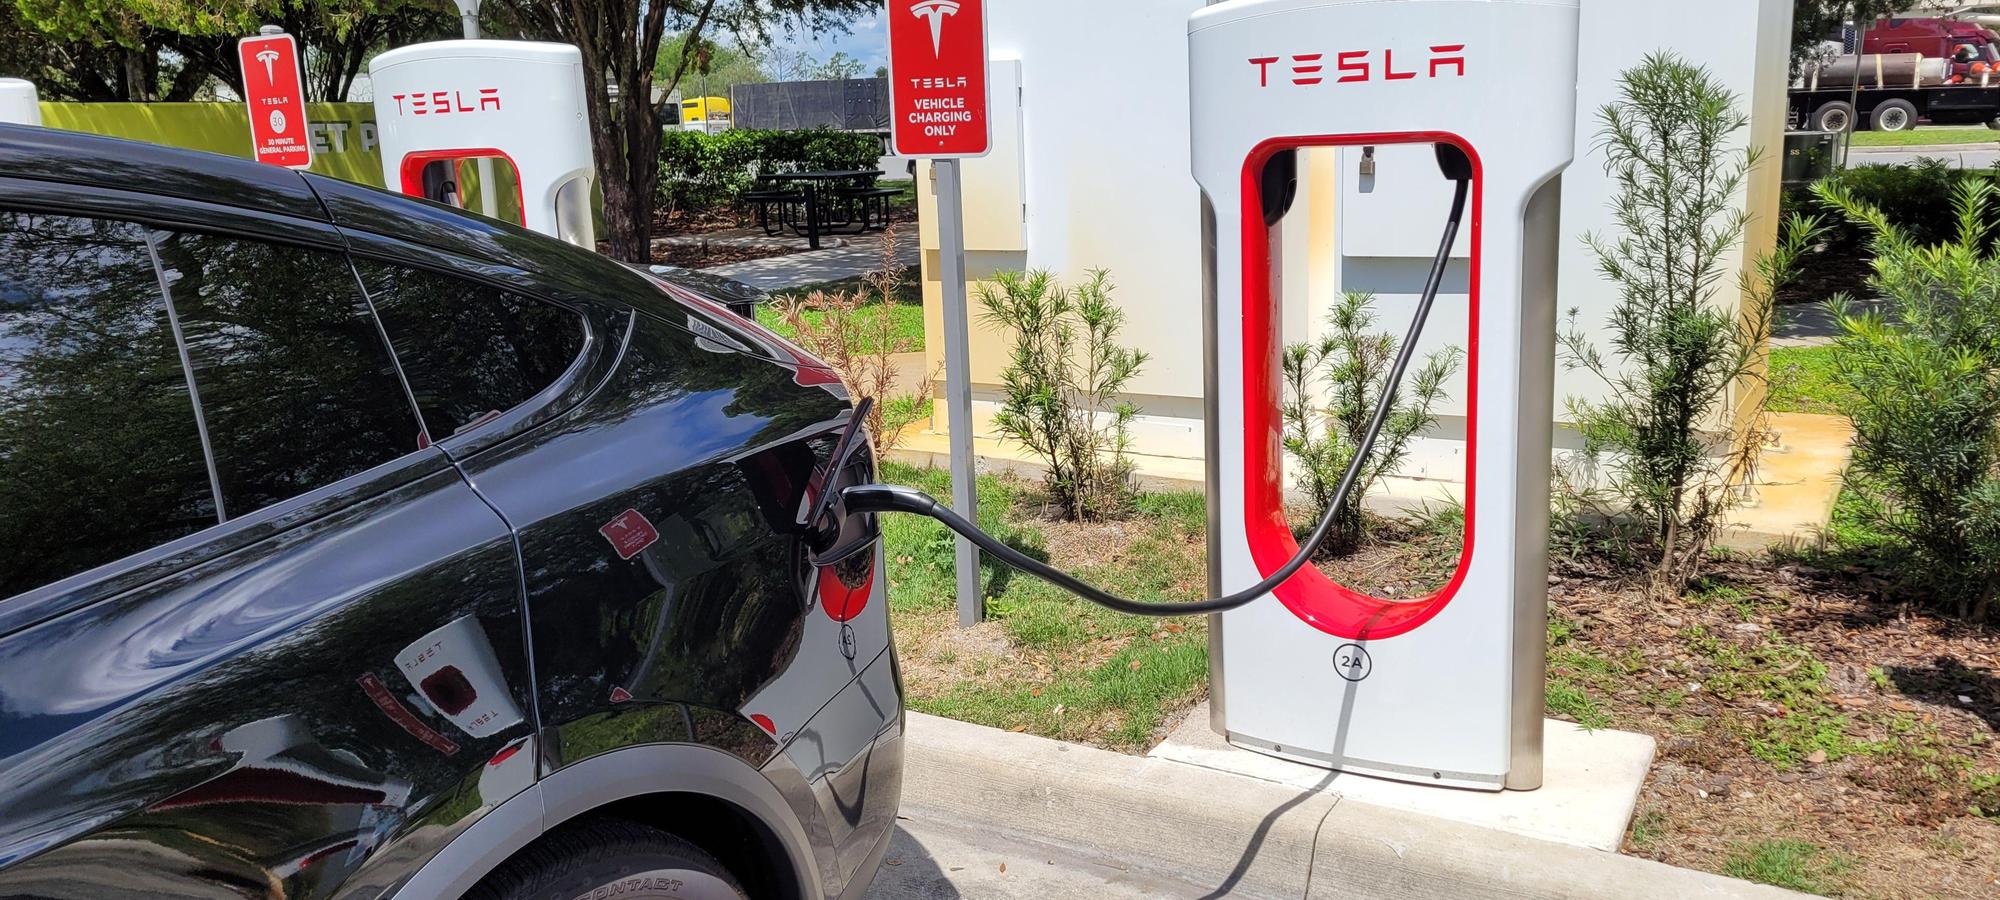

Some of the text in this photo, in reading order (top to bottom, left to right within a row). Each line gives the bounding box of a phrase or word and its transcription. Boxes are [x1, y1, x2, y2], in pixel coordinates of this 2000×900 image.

[1248, 44, 1465, 87] TESLA
[911, 76, 967, 89] TESLA
[261, 96, 289, 105] TESLA
[392, 88, 501, 116] TESLA
[914, 97, 965, 110] VEHICLE
[272, 116, 283, 127] 30
[908, 110, 972, 123] CHARGING
[924, 124, 956, 137] ONLY
[268, 137, 294, 146] 30 MINUTE
[308, 123, 349, 153] ET
[259, 144, 306, 154] GENERAL PARKING
[1341, 655, 1363, 670] 2A
